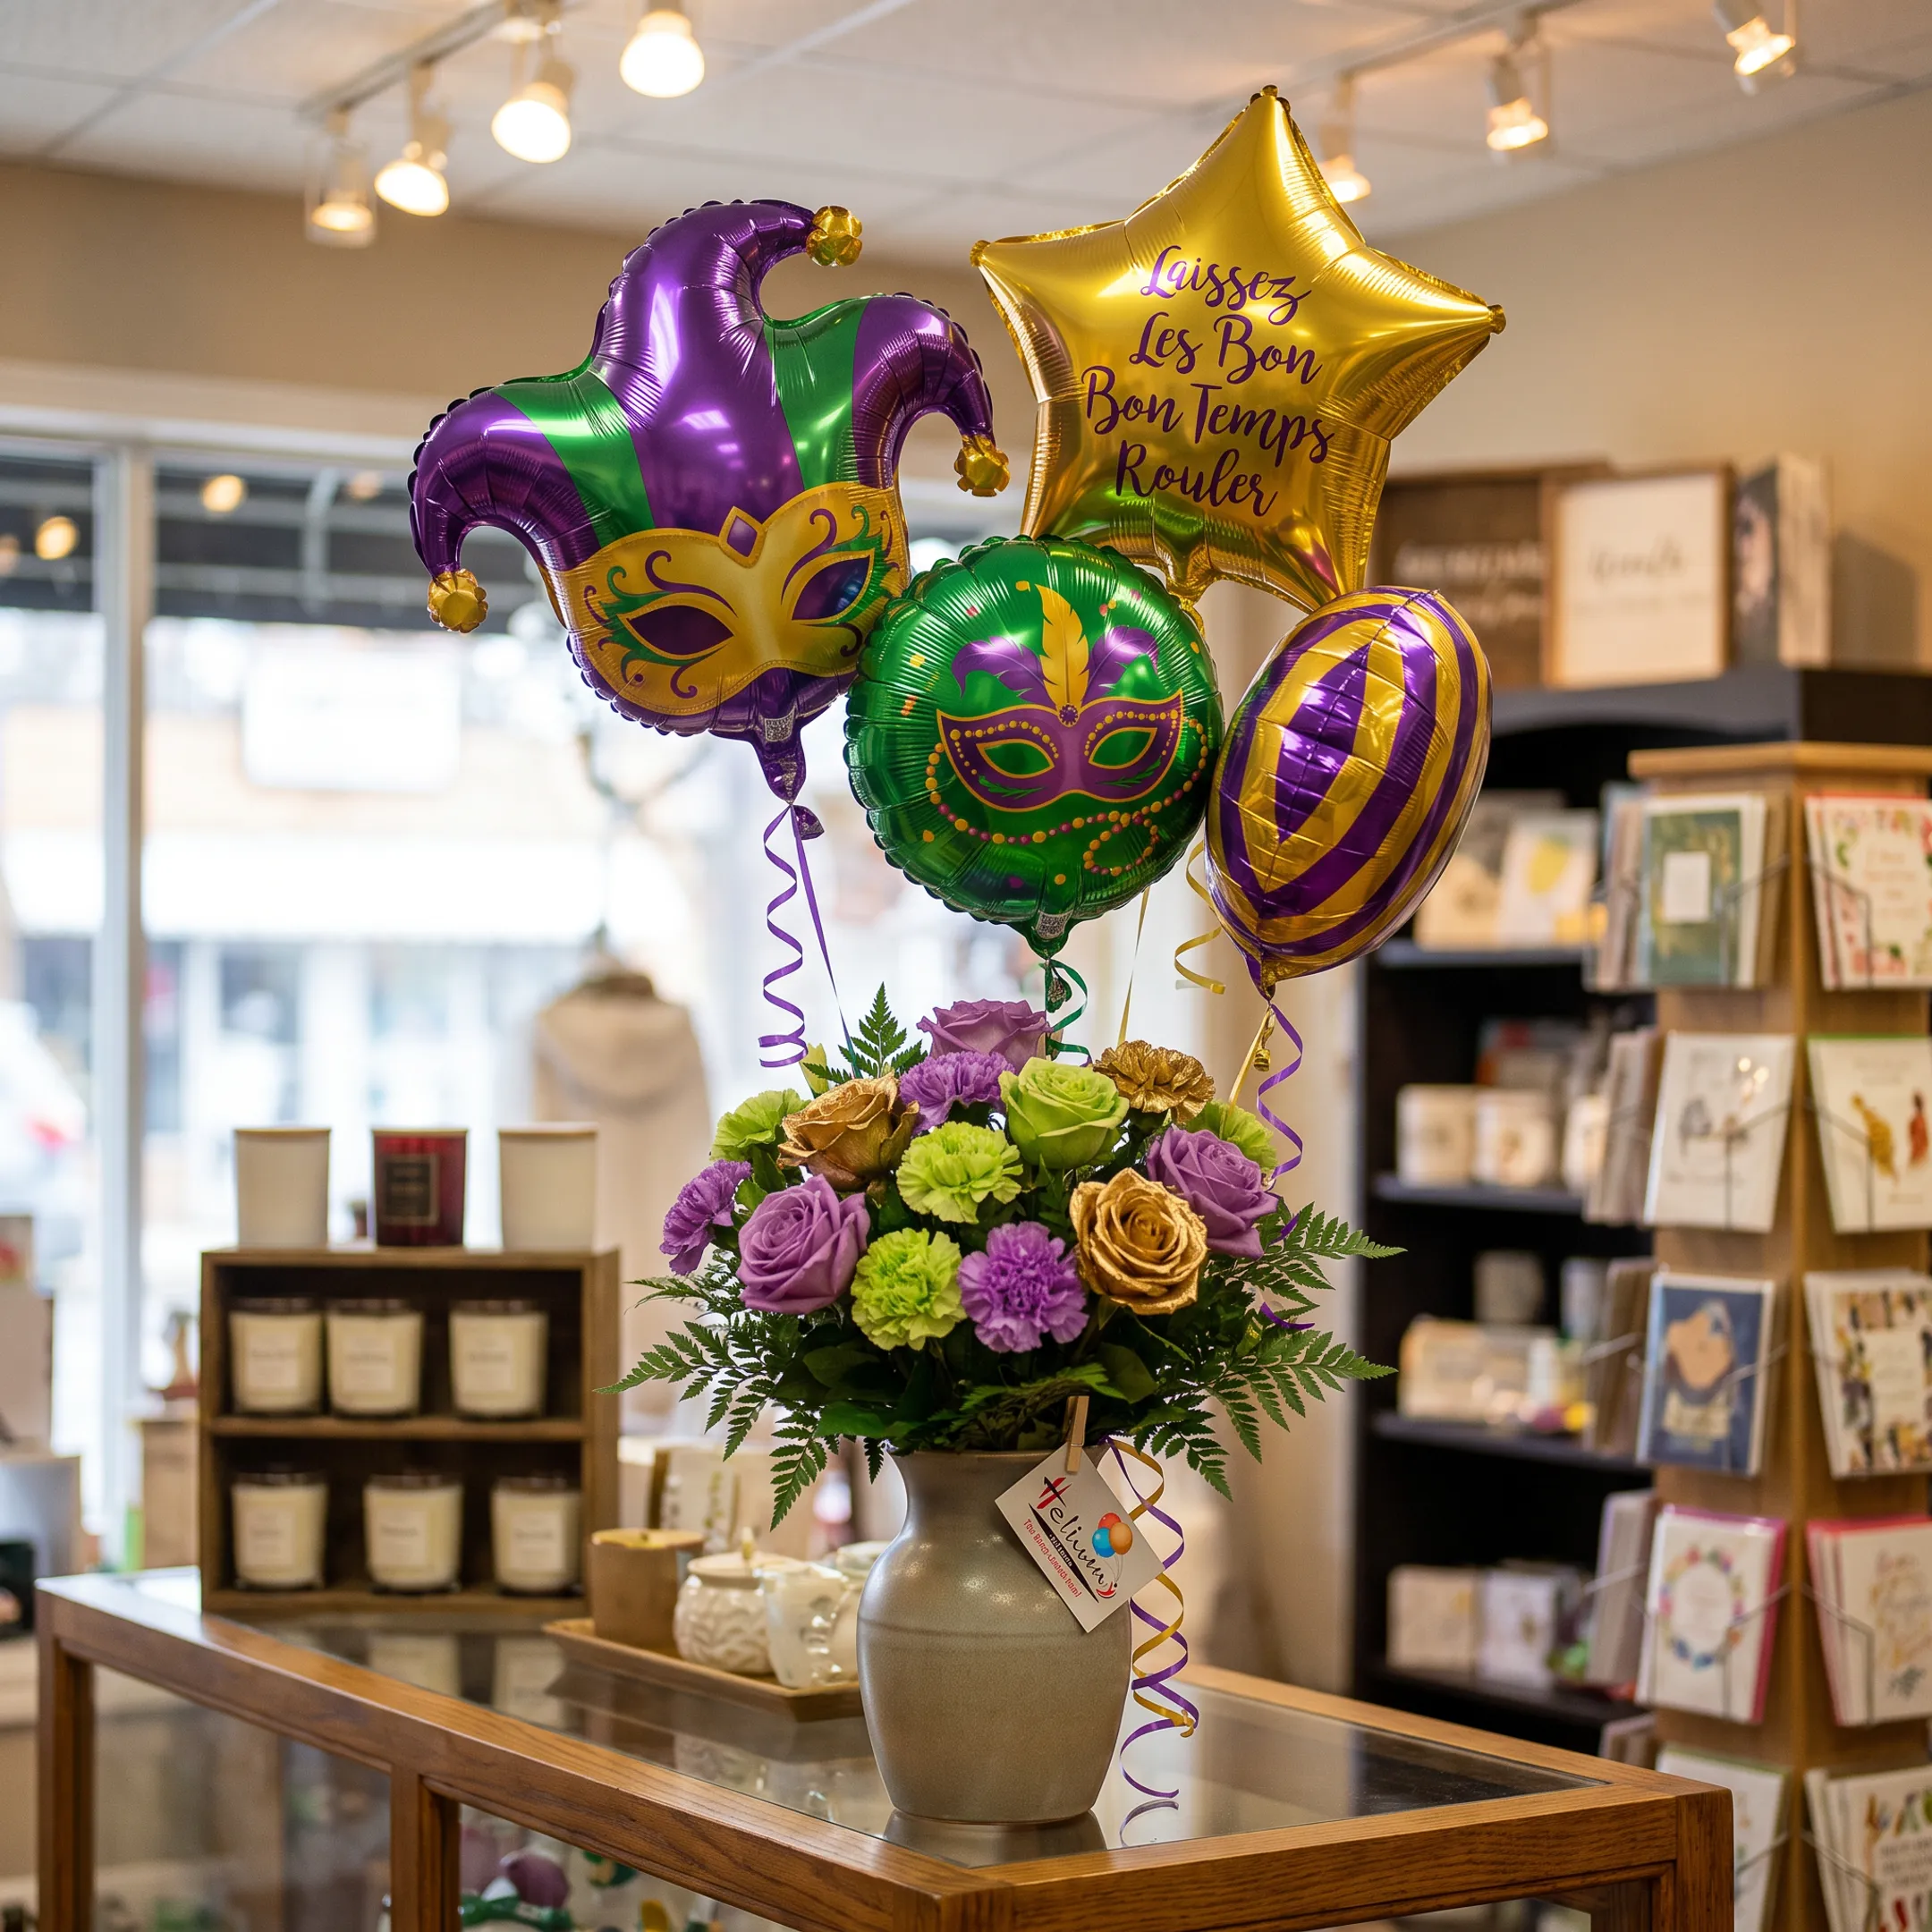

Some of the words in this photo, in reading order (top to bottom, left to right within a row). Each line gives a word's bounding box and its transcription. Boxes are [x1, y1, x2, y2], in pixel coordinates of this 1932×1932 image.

[1140, 245, 1311, 326] Laissez
[1129, 311, 1203, 374] Les
[1214, 314, 1322, 385] Bon
[1080, 365, 1184, 435] Bon
[1190, 383, 1335, 466] Temps
[1115, 439, 1278, 516] Rouler
